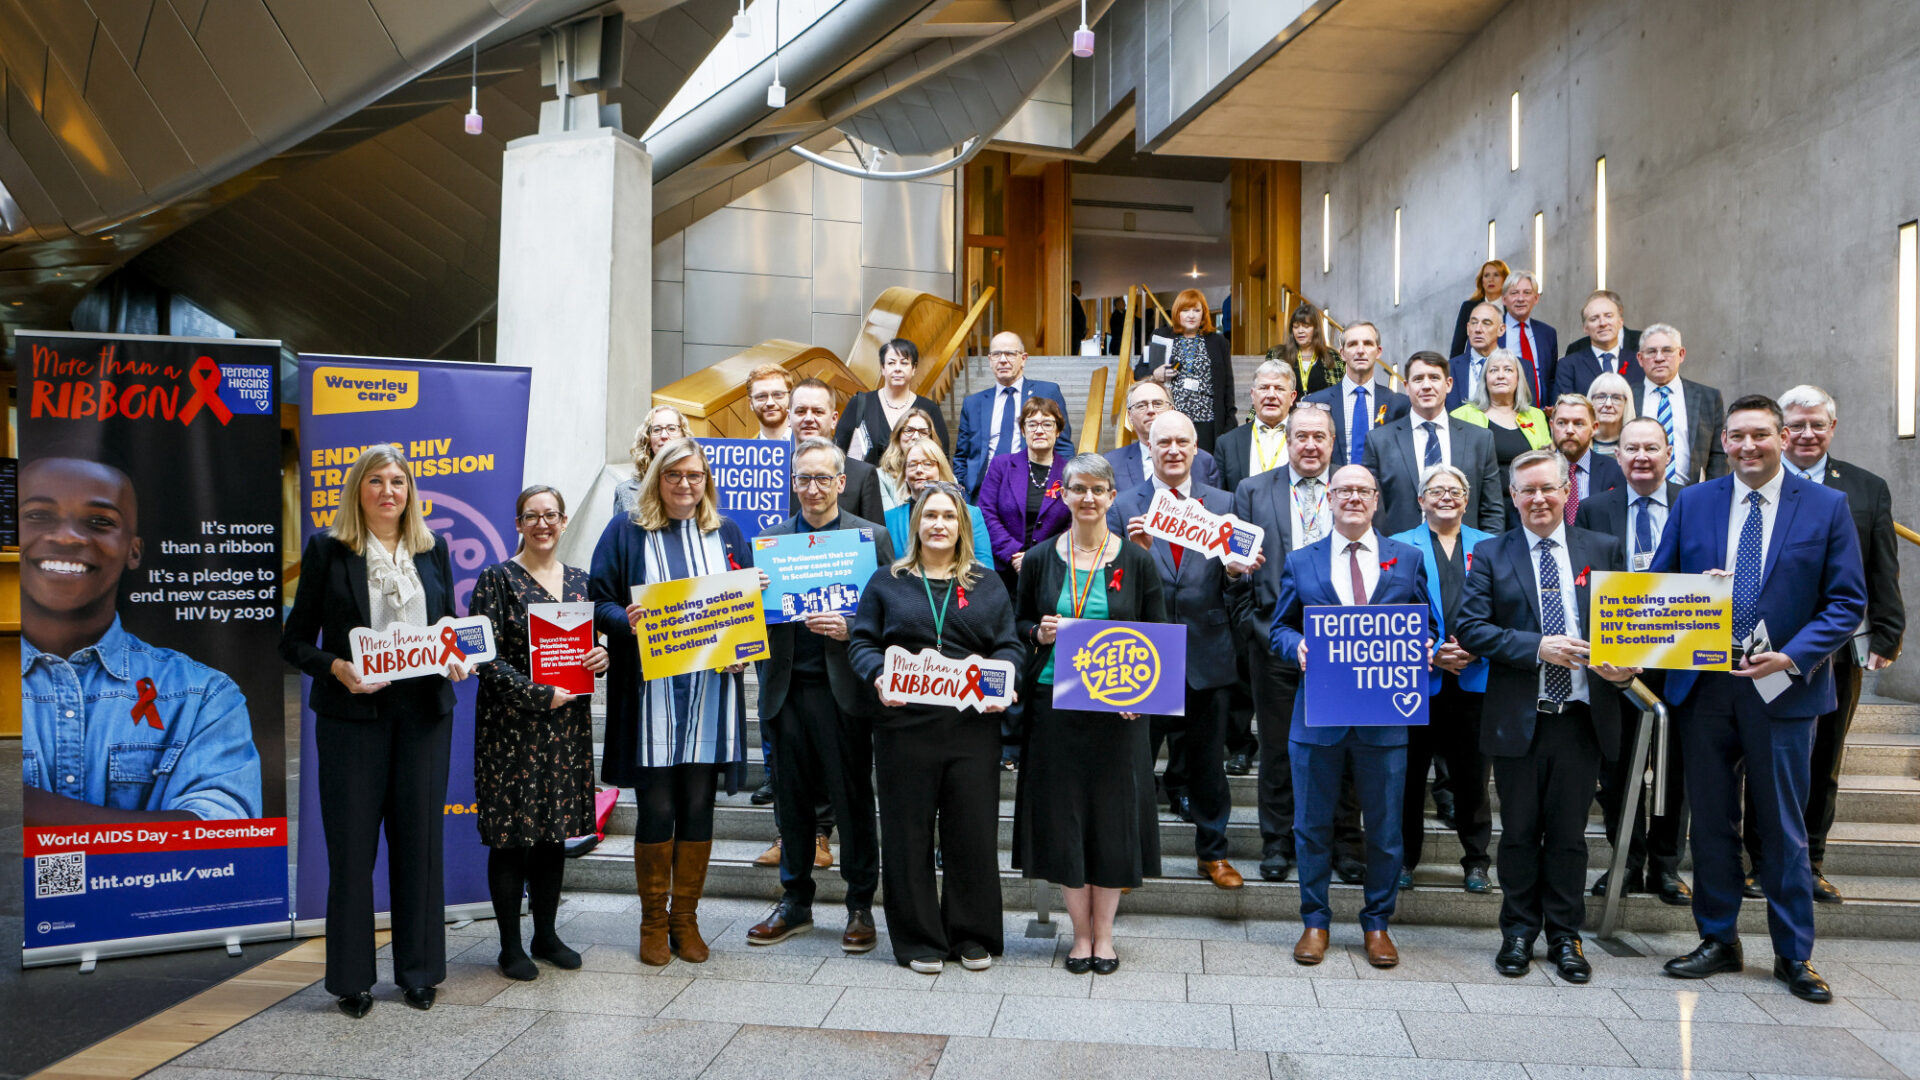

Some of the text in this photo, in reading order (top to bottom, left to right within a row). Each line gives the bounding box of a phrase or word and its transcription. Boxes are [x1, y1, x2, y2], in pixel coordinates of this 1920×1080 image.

[32, 344, 182, 379] More than a
[325, 375, 408, 394] Waverley
[30, 380, 180, 421] RIBBON
[357, 391, 397, 402] care
[410, 438, 452, 458] HIV
[701, 445, 784, 466] errence
[1157, 495, 1181, 516] More
[1183, 505, 1206, 524] than
[201, 521, 274, 534] It's more
[1150, 511, 1213, 546] RIBBON
[161, 540, 274, 554] than a ribbon
[787, 553, 827, 562] Parliament
[149, 568, 275, 585] It's a pledge to
[790, 571, 823, 580] Scotland
[824, 570, 833, 578] by
[129, 586, 276, 602] end new cases of
[664, 600, 703, 614] taking
[706, 590, 743, 605] action
[1622, 594, 1665, 606] taking
[1668, 593, 1711, 603] action
[175, 606, 275, 623] HIV by 2030
[645, 601, 755, 632] to #GetToZero new
[1600, 609, 1613, 618] to
[1616, 608, 1692, 618] #GetToZero
[648, 614, 755, 644] HIV transmissions
[1600, 620, 1720, 631] HIV transmissions
[359, 629, 436, 653] More than a
[650, 634, 718, 657] in Scotland
[1601, 634, 1675, 644] in Scotland
[363, 645, 436, 676] RIBBON
[893, 653, 962, 676] More than a
[890, 672, 960, 698] RIBBON
[1090, 664, 1151, 698] ZERO
[37, 832, 89, 846] World
[93, 830, 133, 843] AIDS
[137, 829, 168, 844] Day
[182, 831, 191, 840] 1
[195, 825, 276, 839] December
[90, 863, 234, 890] tht.org.uk/wad
